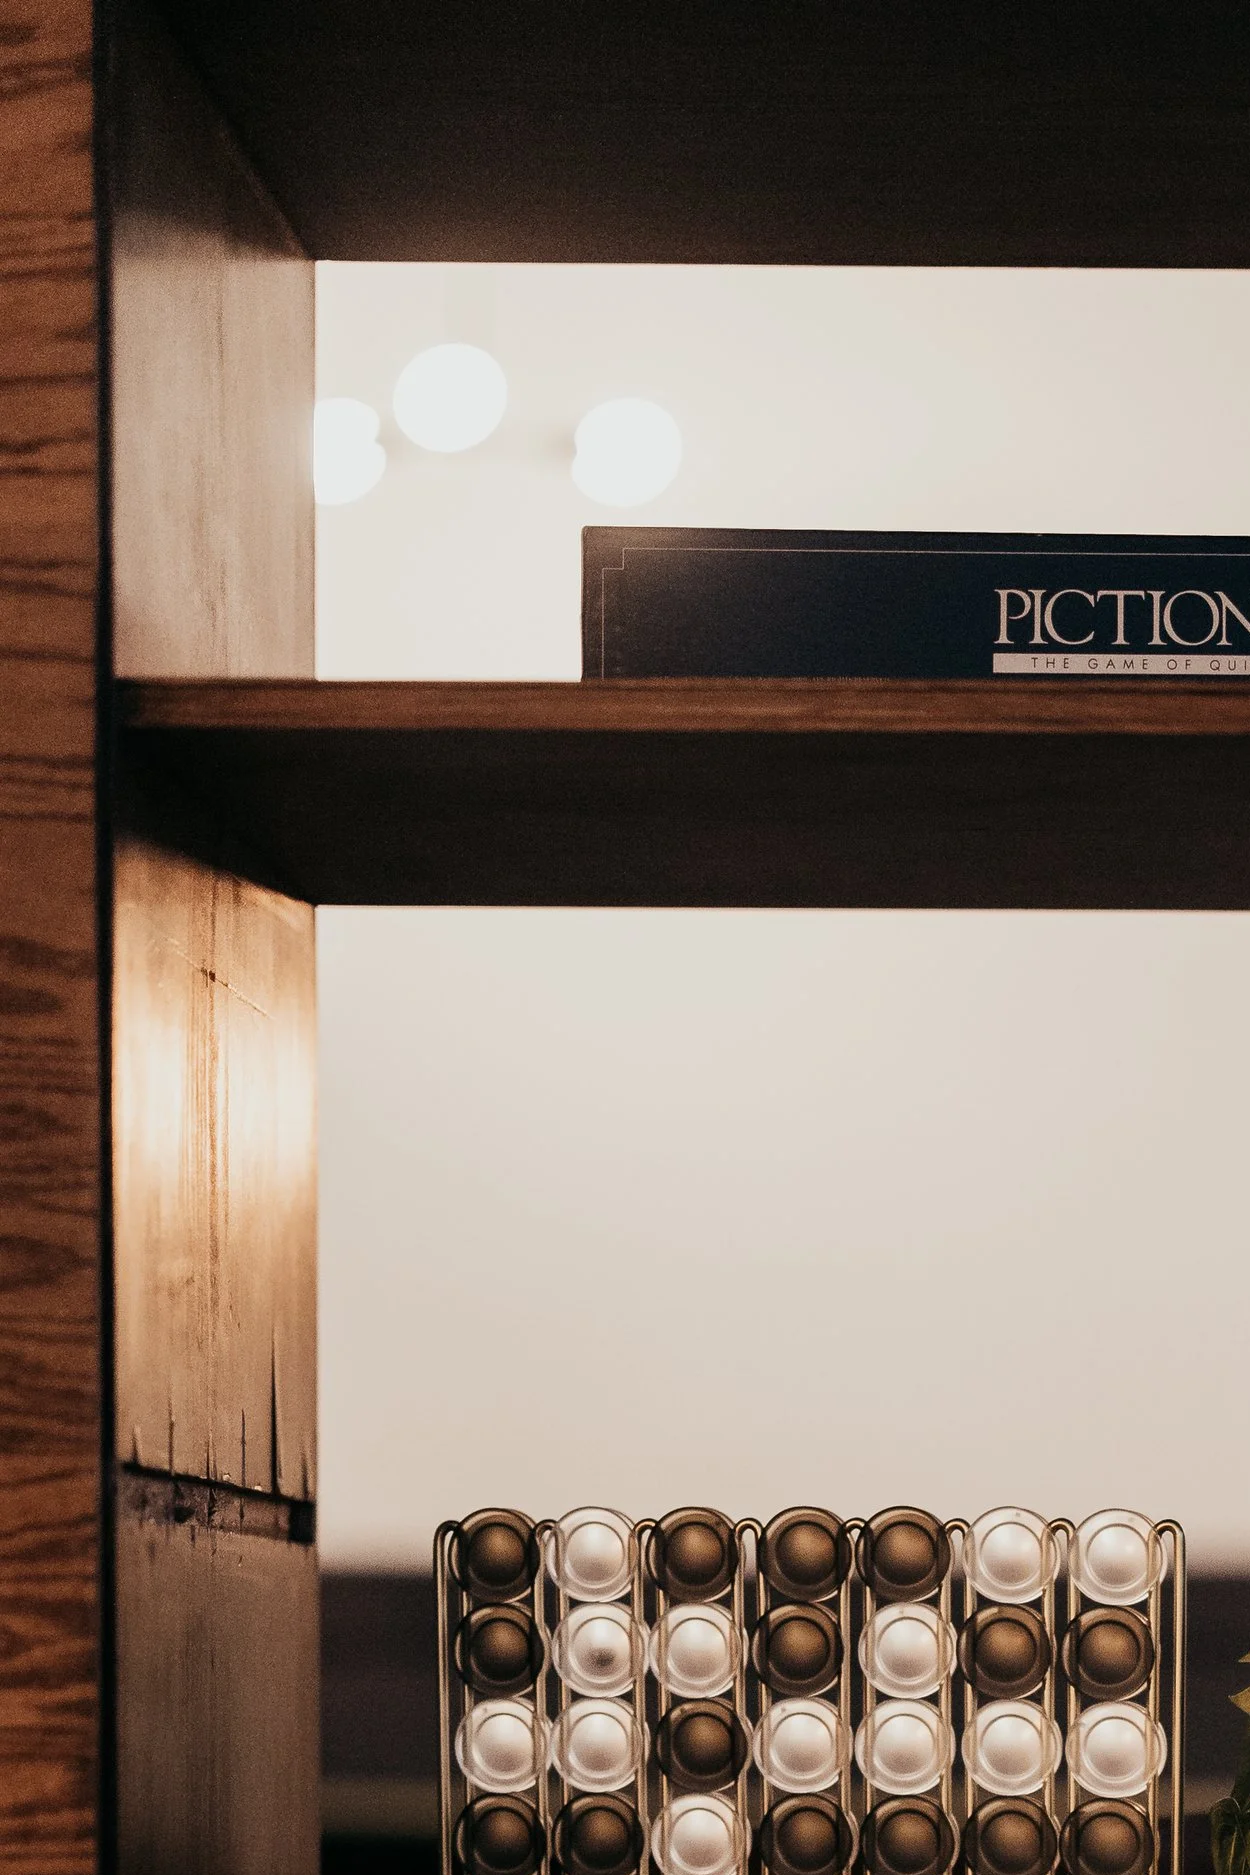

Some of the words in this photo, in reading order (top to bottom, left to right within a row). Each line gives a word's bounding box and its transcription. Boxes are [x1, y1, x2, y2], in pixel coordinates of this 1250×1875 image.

[1031, 657, 1070, 669] THE
[1087, 658, 1149, 670] GAME
[1166, 659, 1191, 671] OF
